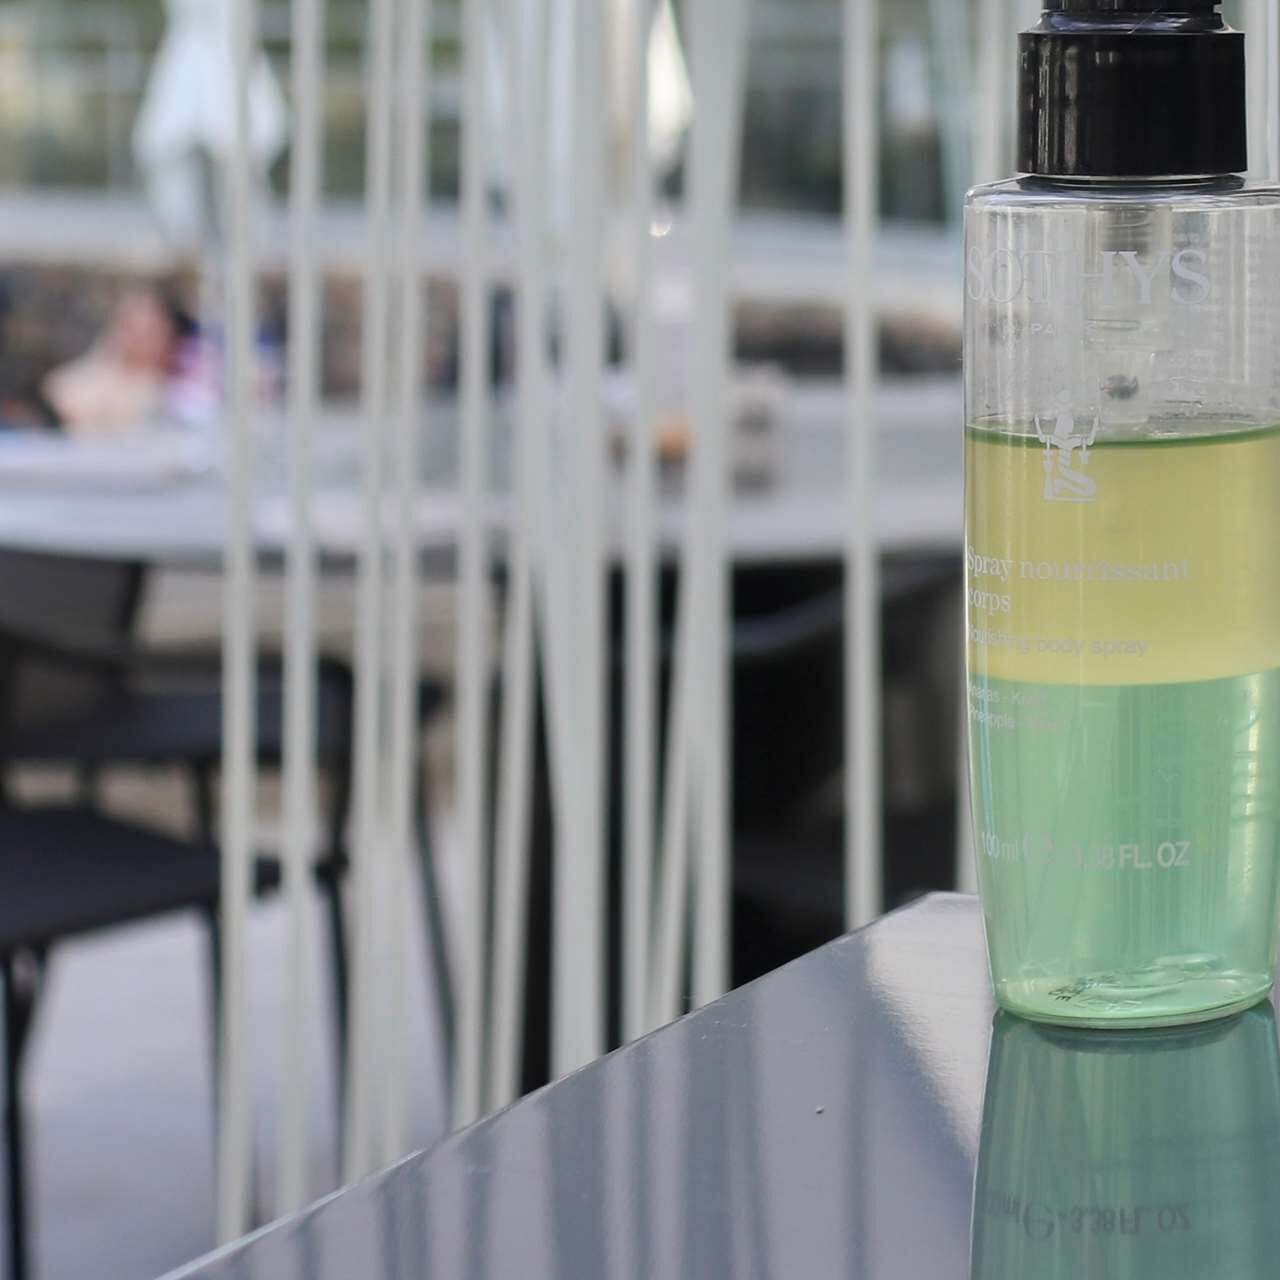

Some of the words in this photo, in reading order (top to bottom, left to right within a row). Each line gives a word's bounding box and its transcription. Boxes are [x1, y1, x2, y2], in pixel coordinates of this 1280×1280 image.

[967, 545, 1012, 581] Spray
[1020, 559, 1192, 581] nourrissant
[1090, 638, 1148, 656] spray
[1157, 842, 1190, 867] OZ
